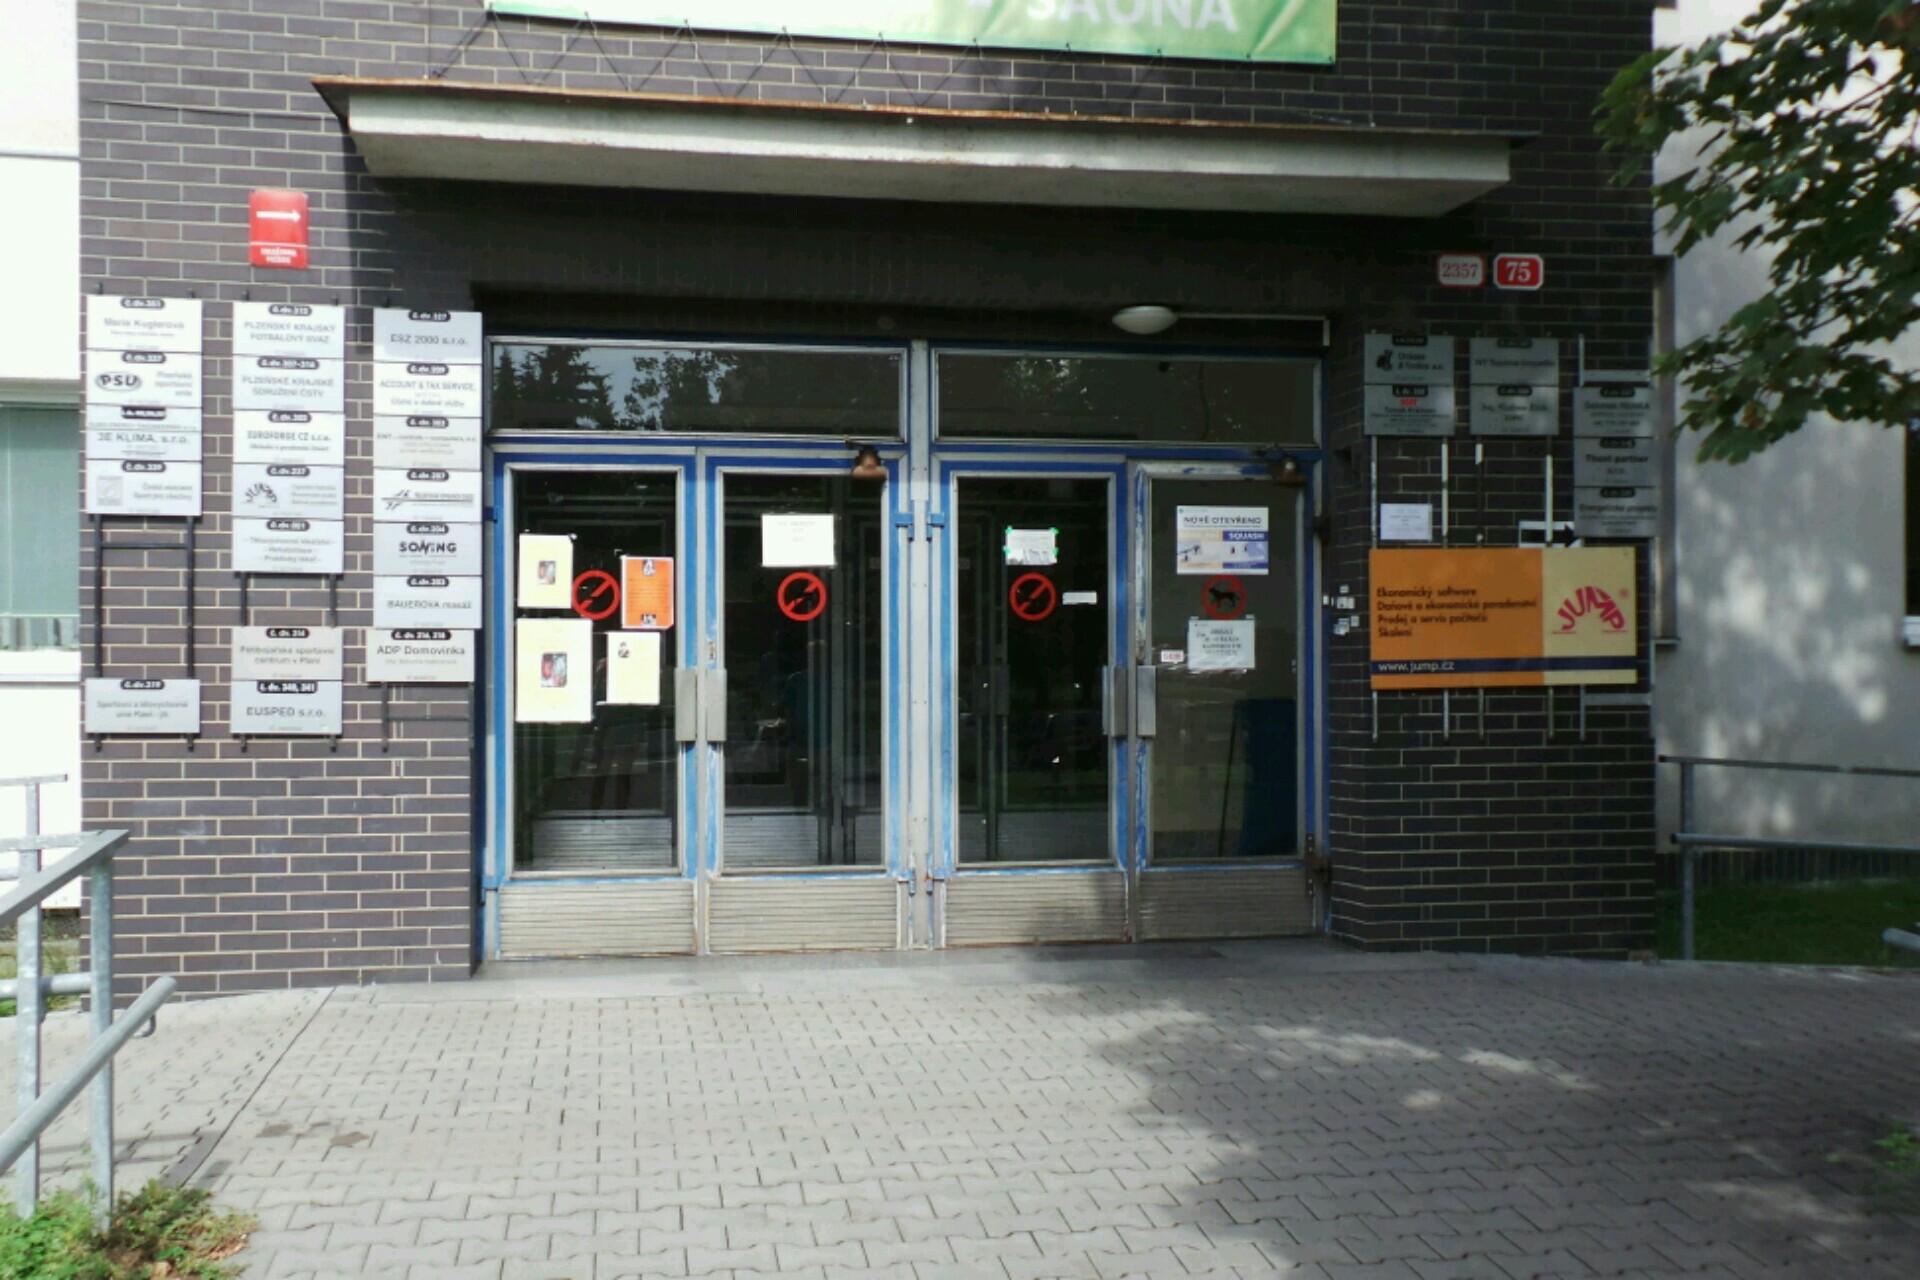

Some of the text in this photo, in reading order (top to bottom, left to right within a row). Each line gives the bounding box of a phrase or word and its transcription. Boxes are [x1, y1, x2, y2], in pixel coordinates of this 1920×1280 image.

[1442, 262, 1479, 279] 2357
[1505, 261, 1531, 282] 75
[414, 334, 440, 344] 2000
[99, 374, 138, 386] PSU
[1228, 532, 1265, 540] SQUASH
[1437, 586, 1476, 597] software
[1557, 586, 1625, 631] JUMP
[1378, 613, 1408, 625] Prodej
[377, 645, 465, 655] ADP Domovinka
[1378, 660, 1455, 673] www.jump.cz
